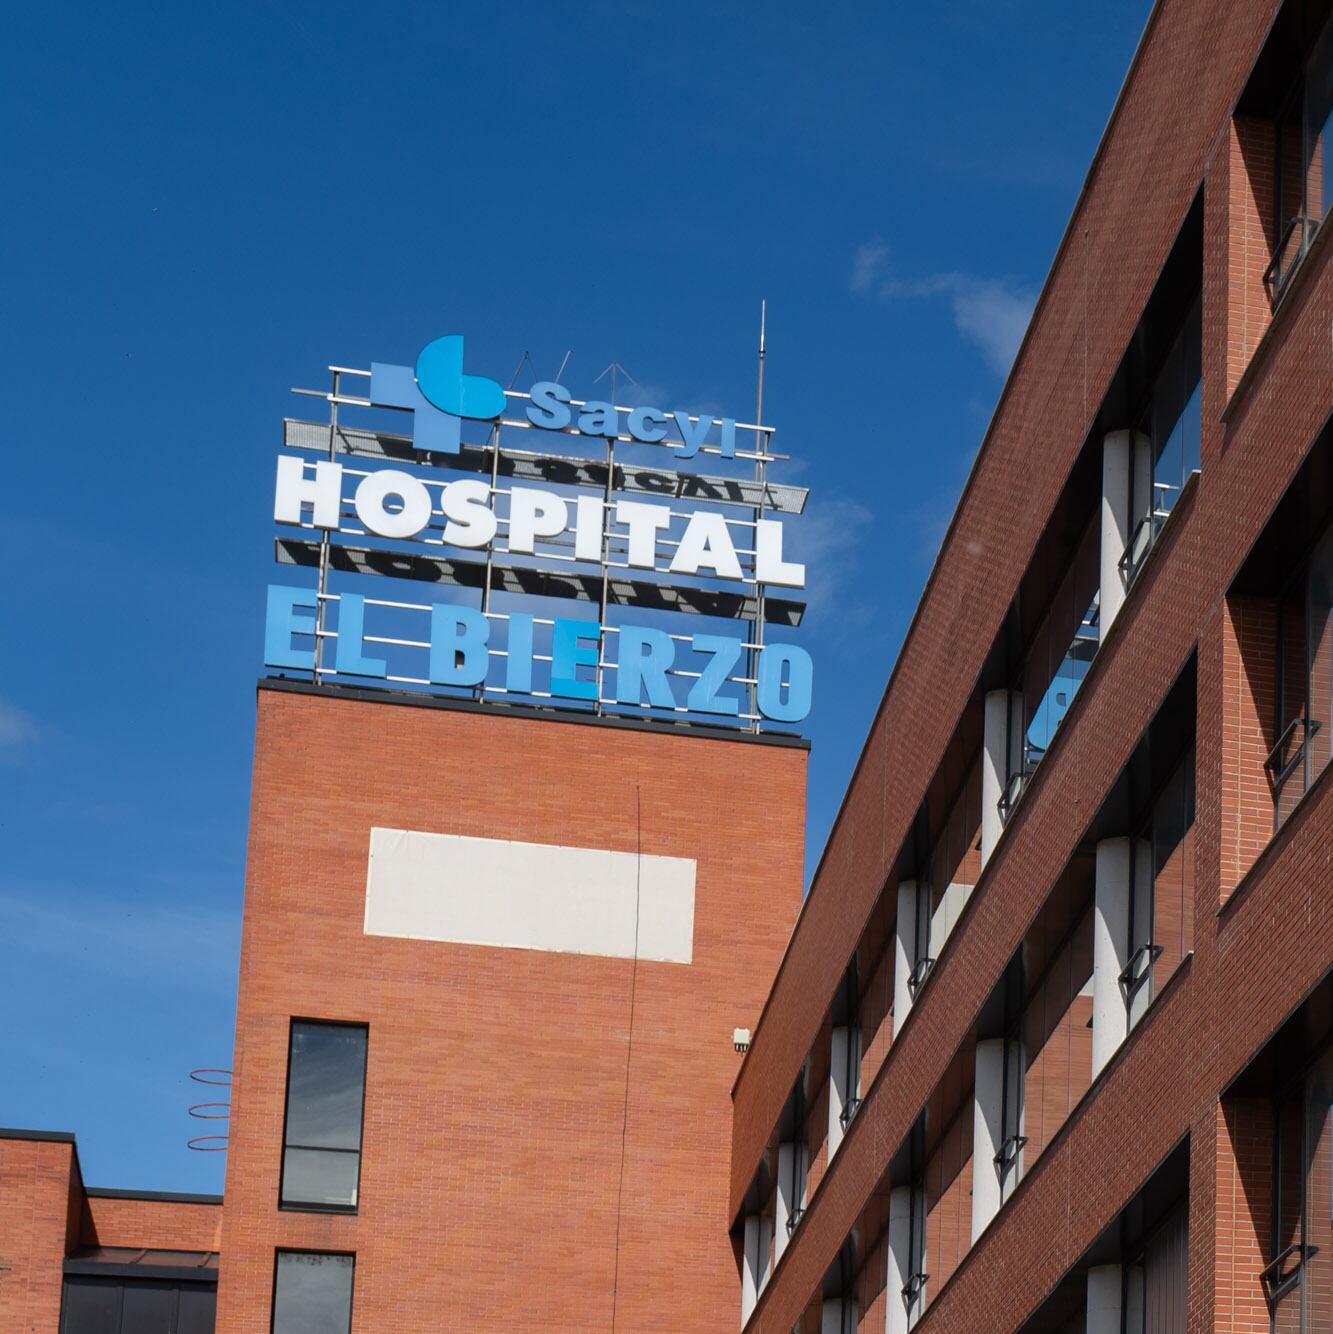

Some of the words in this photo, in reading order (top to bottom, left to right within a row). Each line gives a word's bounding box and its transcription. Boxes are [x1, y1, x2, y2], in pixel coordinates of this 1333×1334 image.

[525, 381, 736, 459] Sacyl
[274, 455, 805, 589] HOSPITAL
[264, 584, 386, 678] EL
[430, 602, 814, 723] BIERZO
